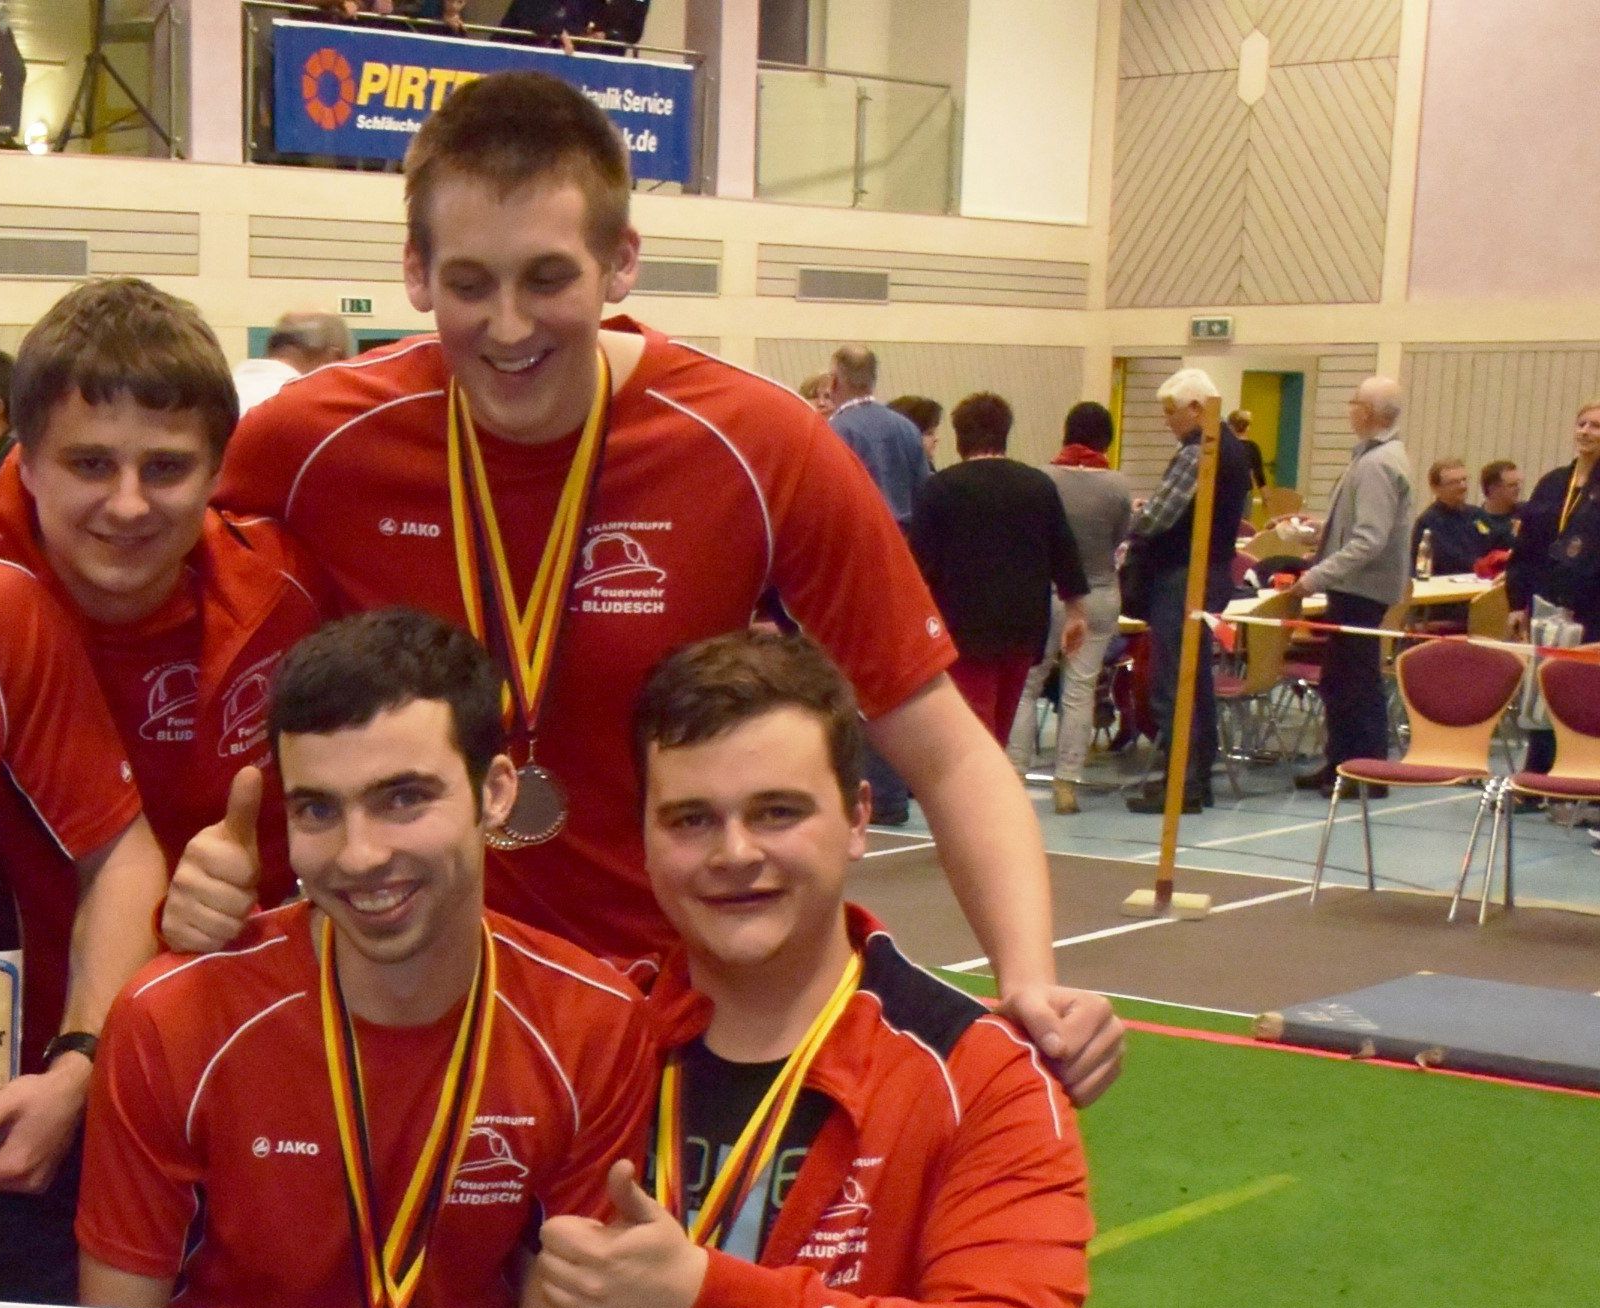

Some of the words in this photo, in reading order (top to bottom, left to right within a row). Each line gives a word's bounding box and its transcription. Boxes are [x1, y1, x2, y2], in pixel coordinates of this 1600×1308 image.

[622, 88, 675, 115] Service
[400, 522, 440, 538] JAKO
[593, 586, 665, 598] Feuerwehr
[582, 600, 665, 614] BLUDESCH
[275, 1140, 319, 1155] JAKO
